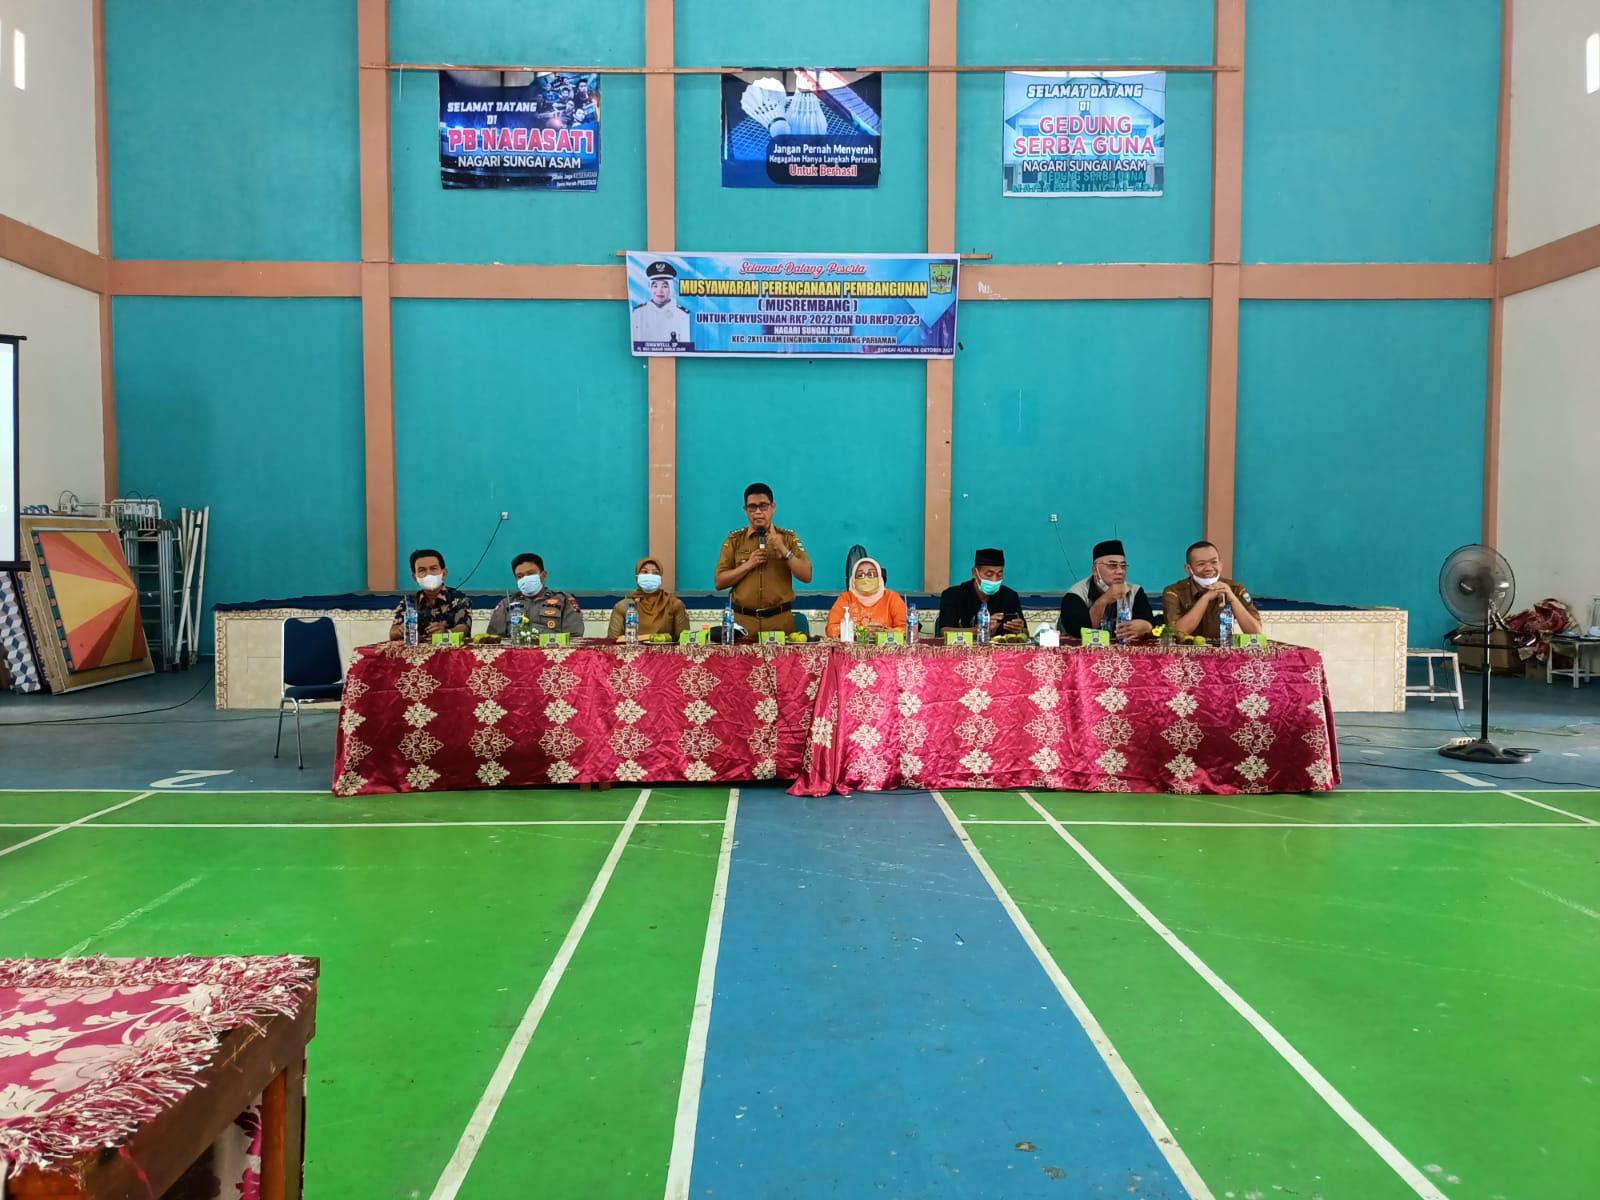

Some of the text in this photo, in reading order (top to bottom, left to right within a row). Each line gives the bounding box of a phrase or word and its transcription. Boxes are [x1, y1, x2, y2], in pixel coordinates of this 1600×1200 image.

[1027, 83, 1143, 98] SELAMAT DATANG
[447, 102, 537, 112] SELAMAT DATANG
[1079, 102, 1090, 112] DI
[487, 115, 497, 125] DI
[1039, 115, 1132, 135] GEDUNG
[448, 128, 594, 154] PB NAGASATI
[1014, 136, 1156, 156] SERBA GUNA
[773, 144, 873, 157] Jangan Pernah Menyerah
[458, 156, 581, 168] NAGARI SUNGAI ASAM
[769, 155, 801, 164] Kegagalan
[802, 155, 822, 164] Hanya
[823, 155, 850, 165] Langkah
[1023, 160, 1147, 172] NAGARI SUNGAI ASAM
[789, 164, 857, 176] Untuk Berhasil
[739, 262, 866, 279] Selamat Datang Peserta
[679, 279, 928, 298] MUSYAWARAH PERENCANAAN PEMBANGUNAN
[696, 314, 920, 325] UNTUK PENYUSUNAN RKP 2022 DAN DU RKPD 2023
[774, 326, 800, 334] NAGARI
[801, 326, 828, 334] SUNGAI
